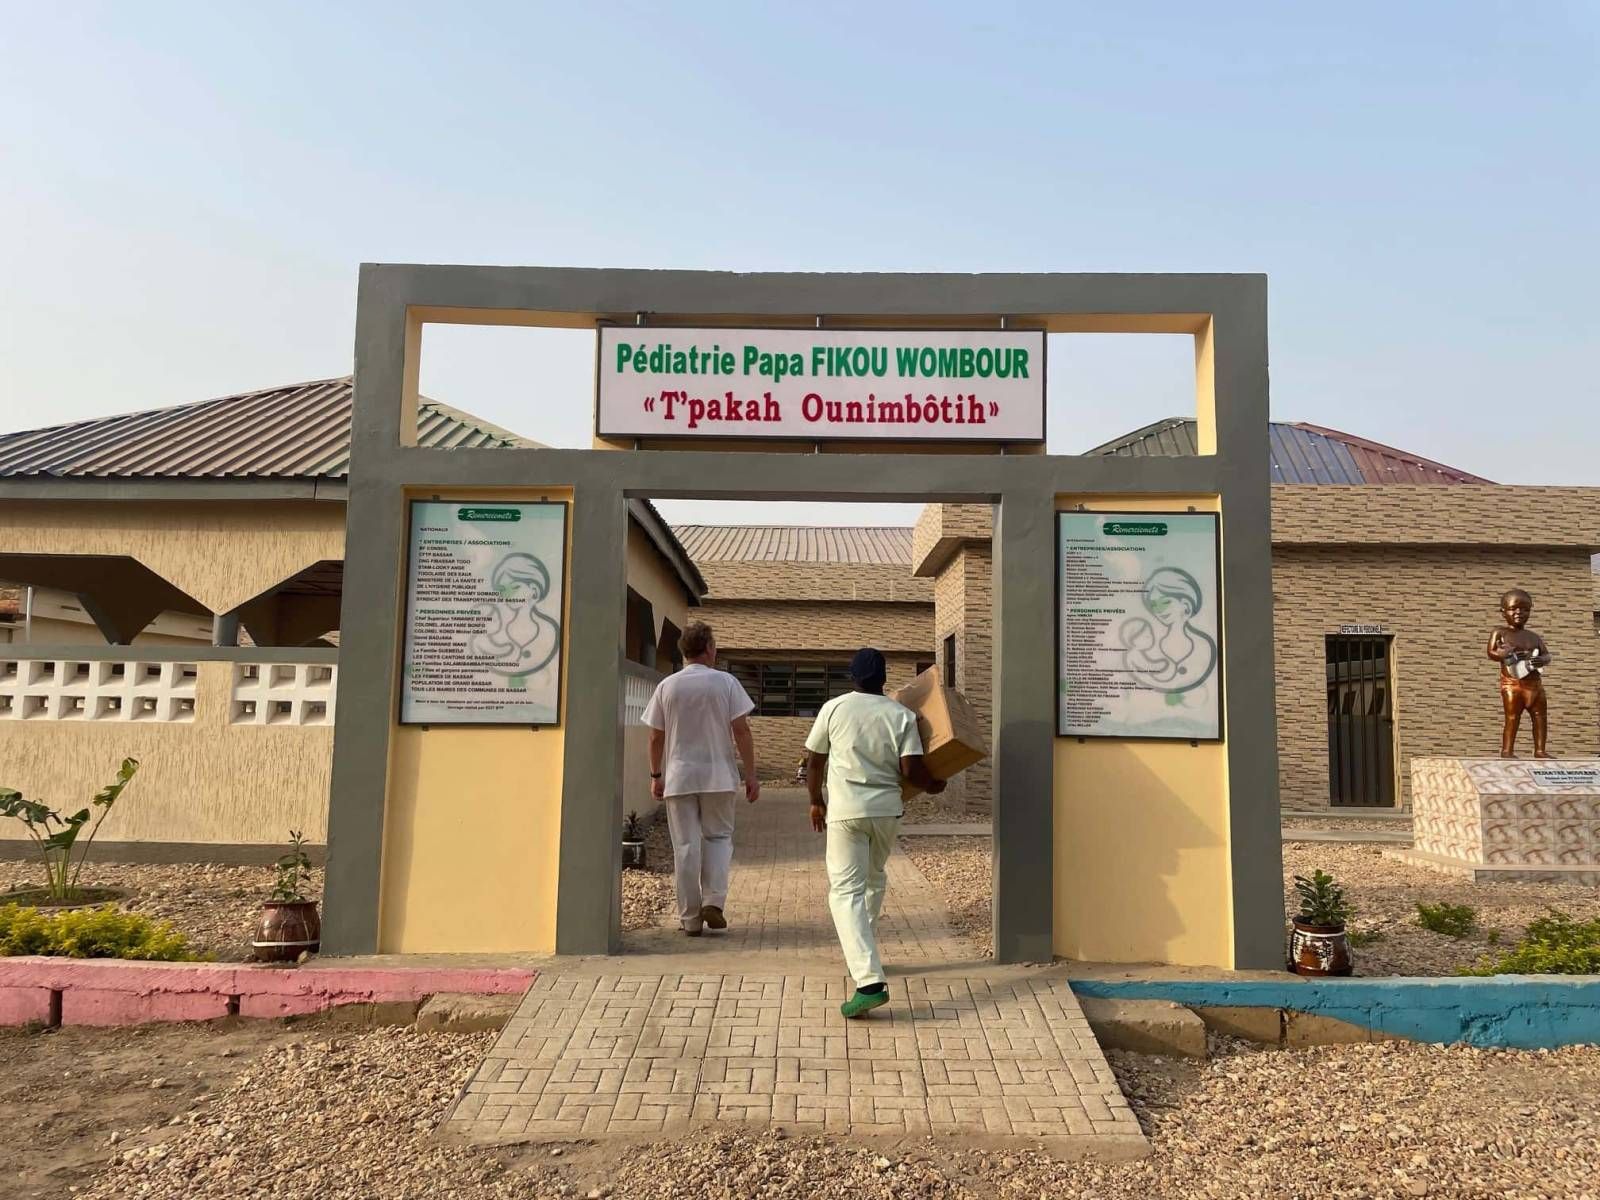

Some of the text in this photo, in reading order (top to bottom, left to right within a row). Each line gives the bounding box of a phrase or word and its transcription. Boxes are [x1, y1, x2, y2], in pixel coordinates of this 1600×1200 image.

[617, 343, 1028, 382] Pédiatrie Papa FIKOU WOMBOUR
